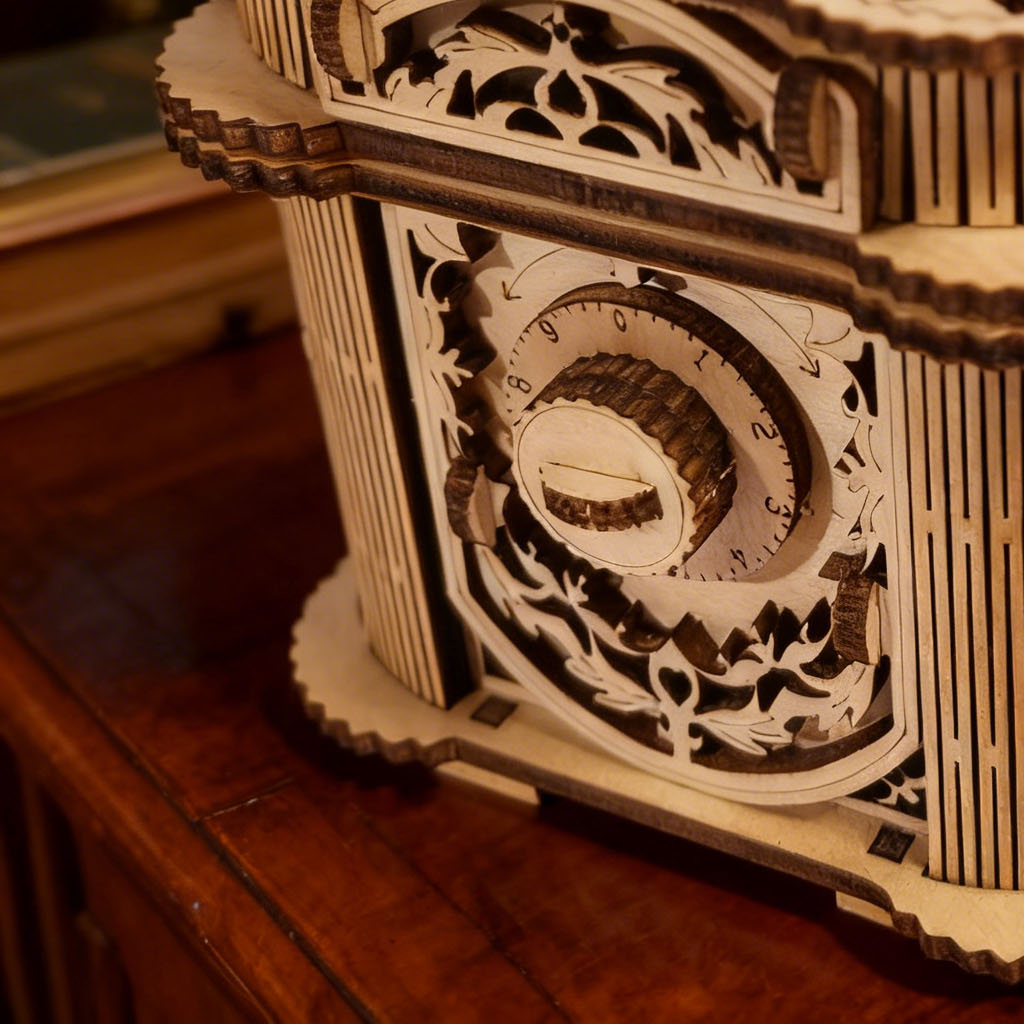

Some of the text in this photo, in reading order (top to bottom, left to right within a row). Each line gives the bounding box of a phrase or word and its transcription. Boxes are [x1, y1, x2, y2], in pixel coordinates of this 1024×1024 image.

[538, 319, 559, 343] 9
[614, 309, 627, 332] 0
[694, 350, 709, 371] 1
[507, 375, 532, 393] 8
[751, 421, 778, 440] 2
[730, 548, 748, 570] 4
